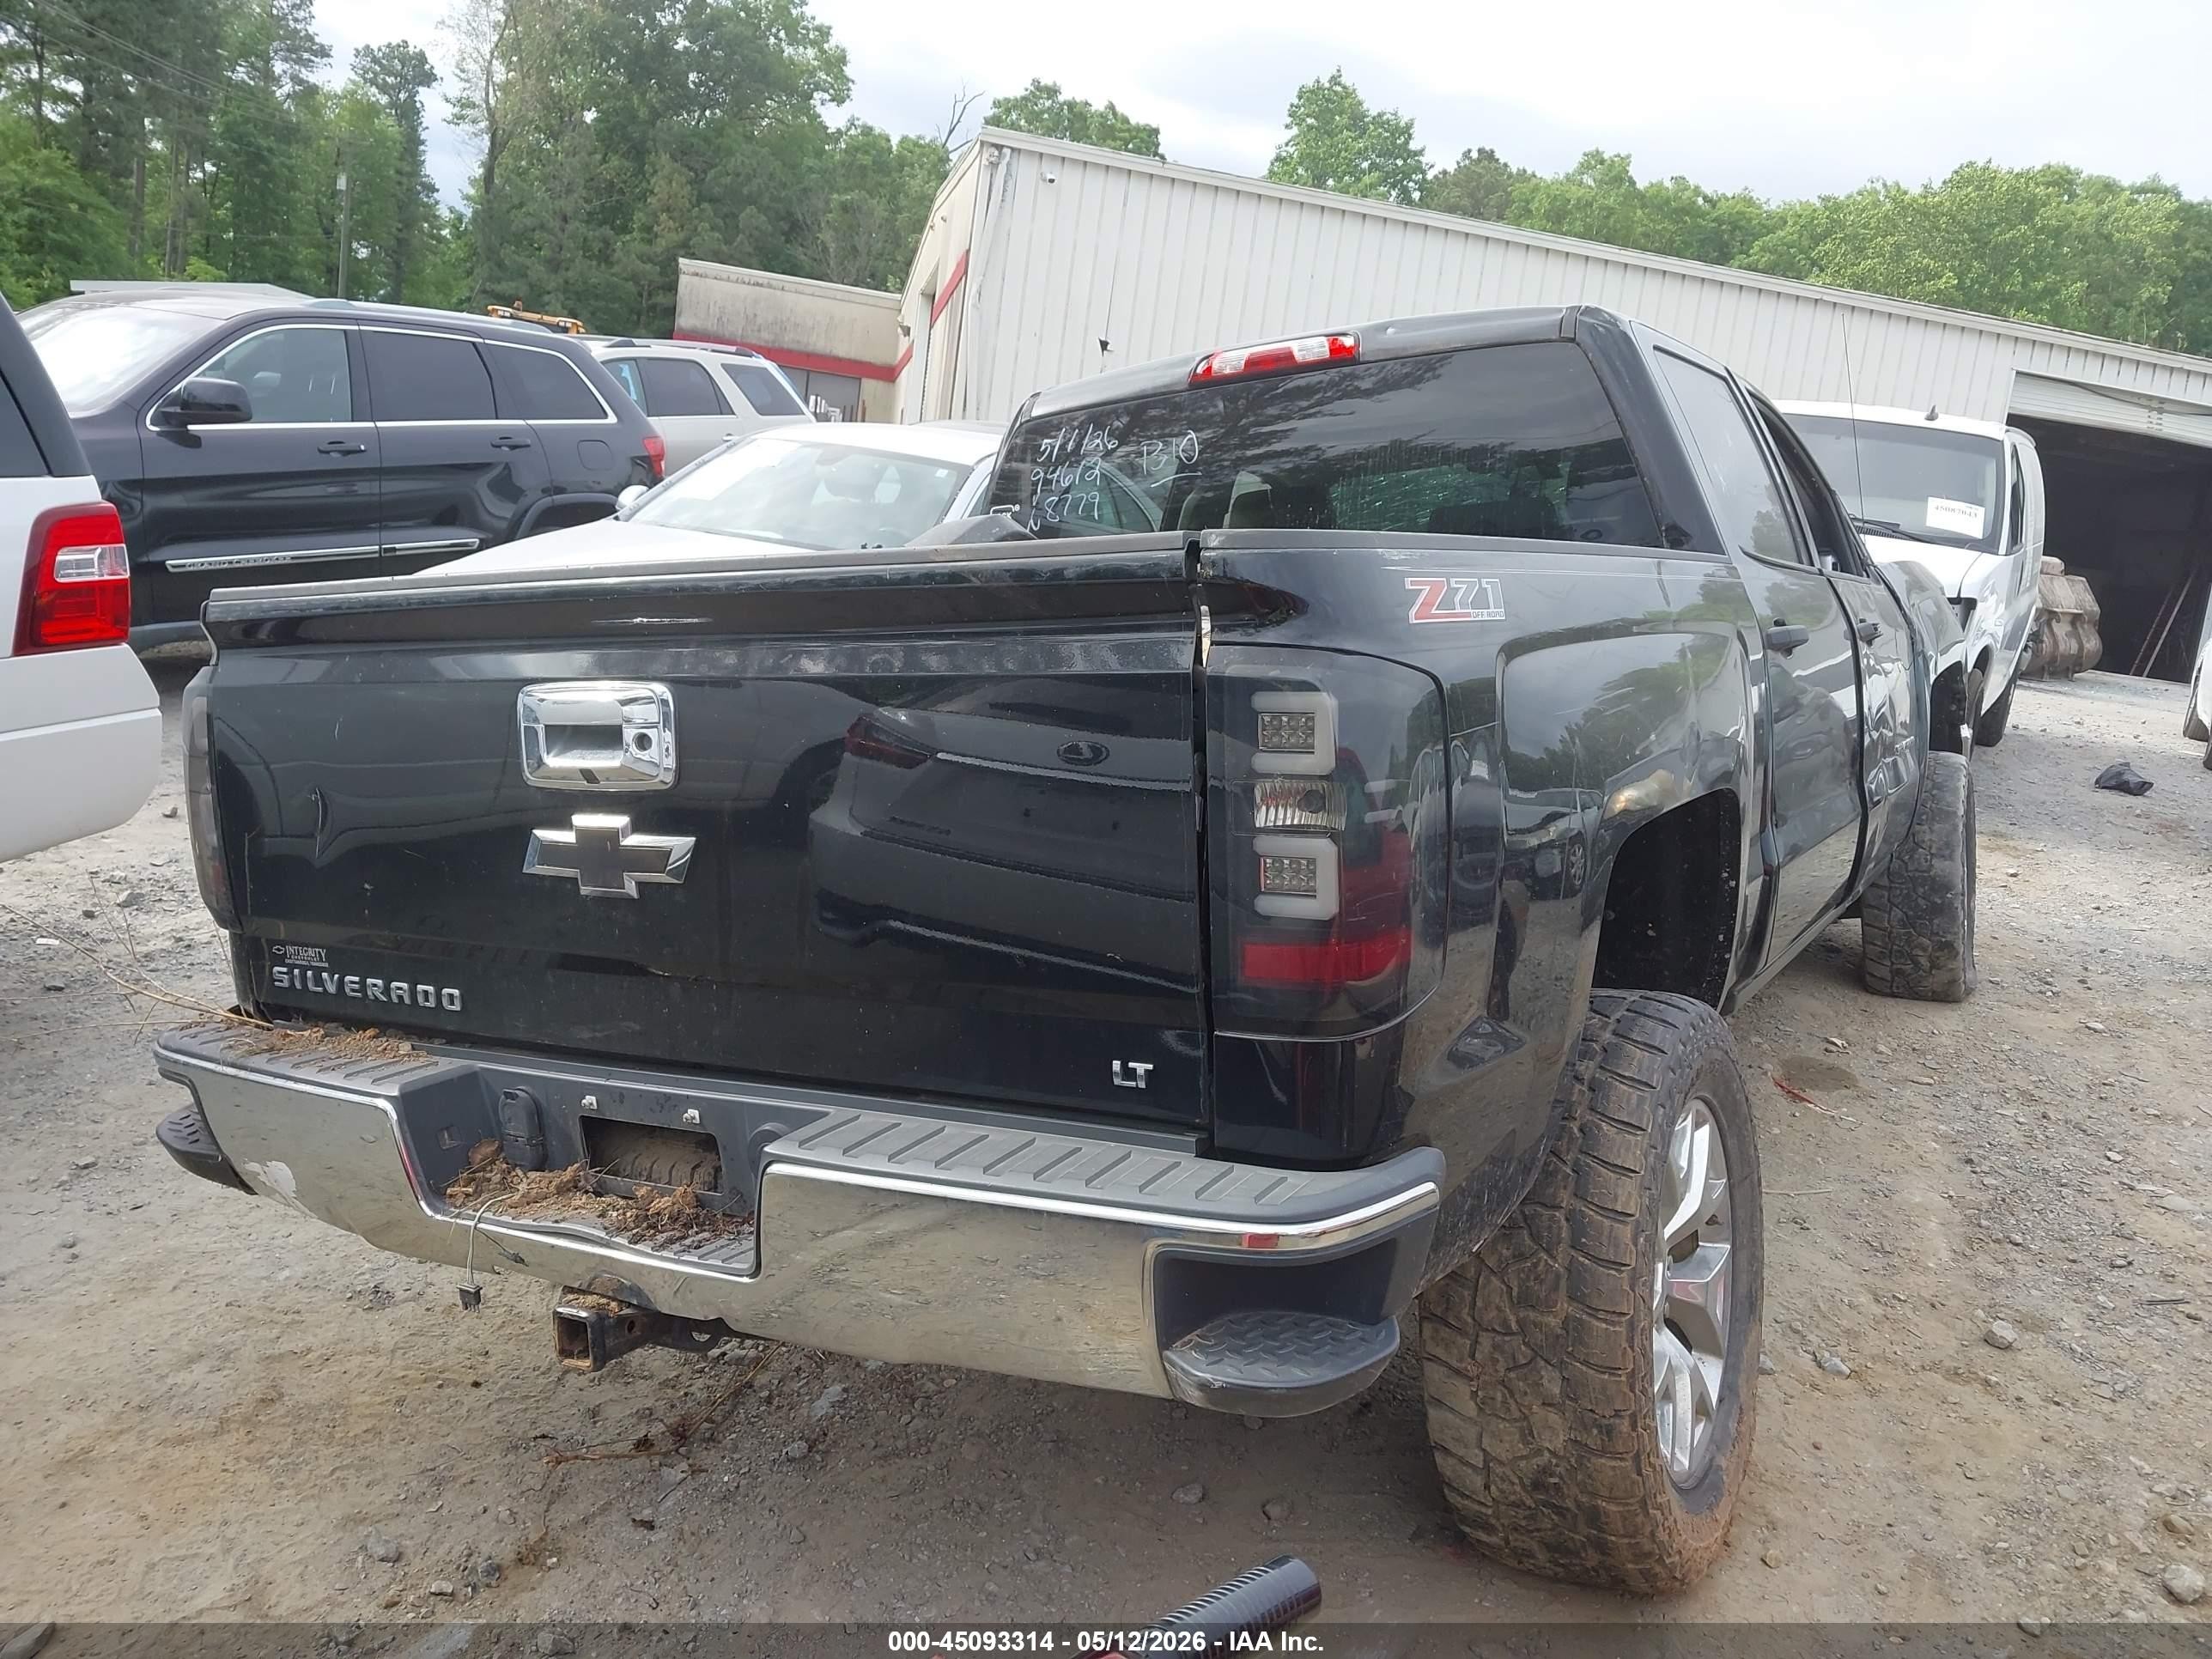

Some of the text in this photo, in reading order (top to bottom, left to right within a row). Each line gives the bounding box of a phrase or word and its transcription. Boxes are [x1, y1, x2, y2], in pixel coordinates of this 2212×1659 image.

[1404, 577, 1504, 623] Z71
[1471, 610, 1504, 619] OFF ROAD
[285, 945, 326, 962] INTEGRITY
[272, 966, 462, 1012] SILVERADO
[1112, 1060, 1154, 1089] LT
